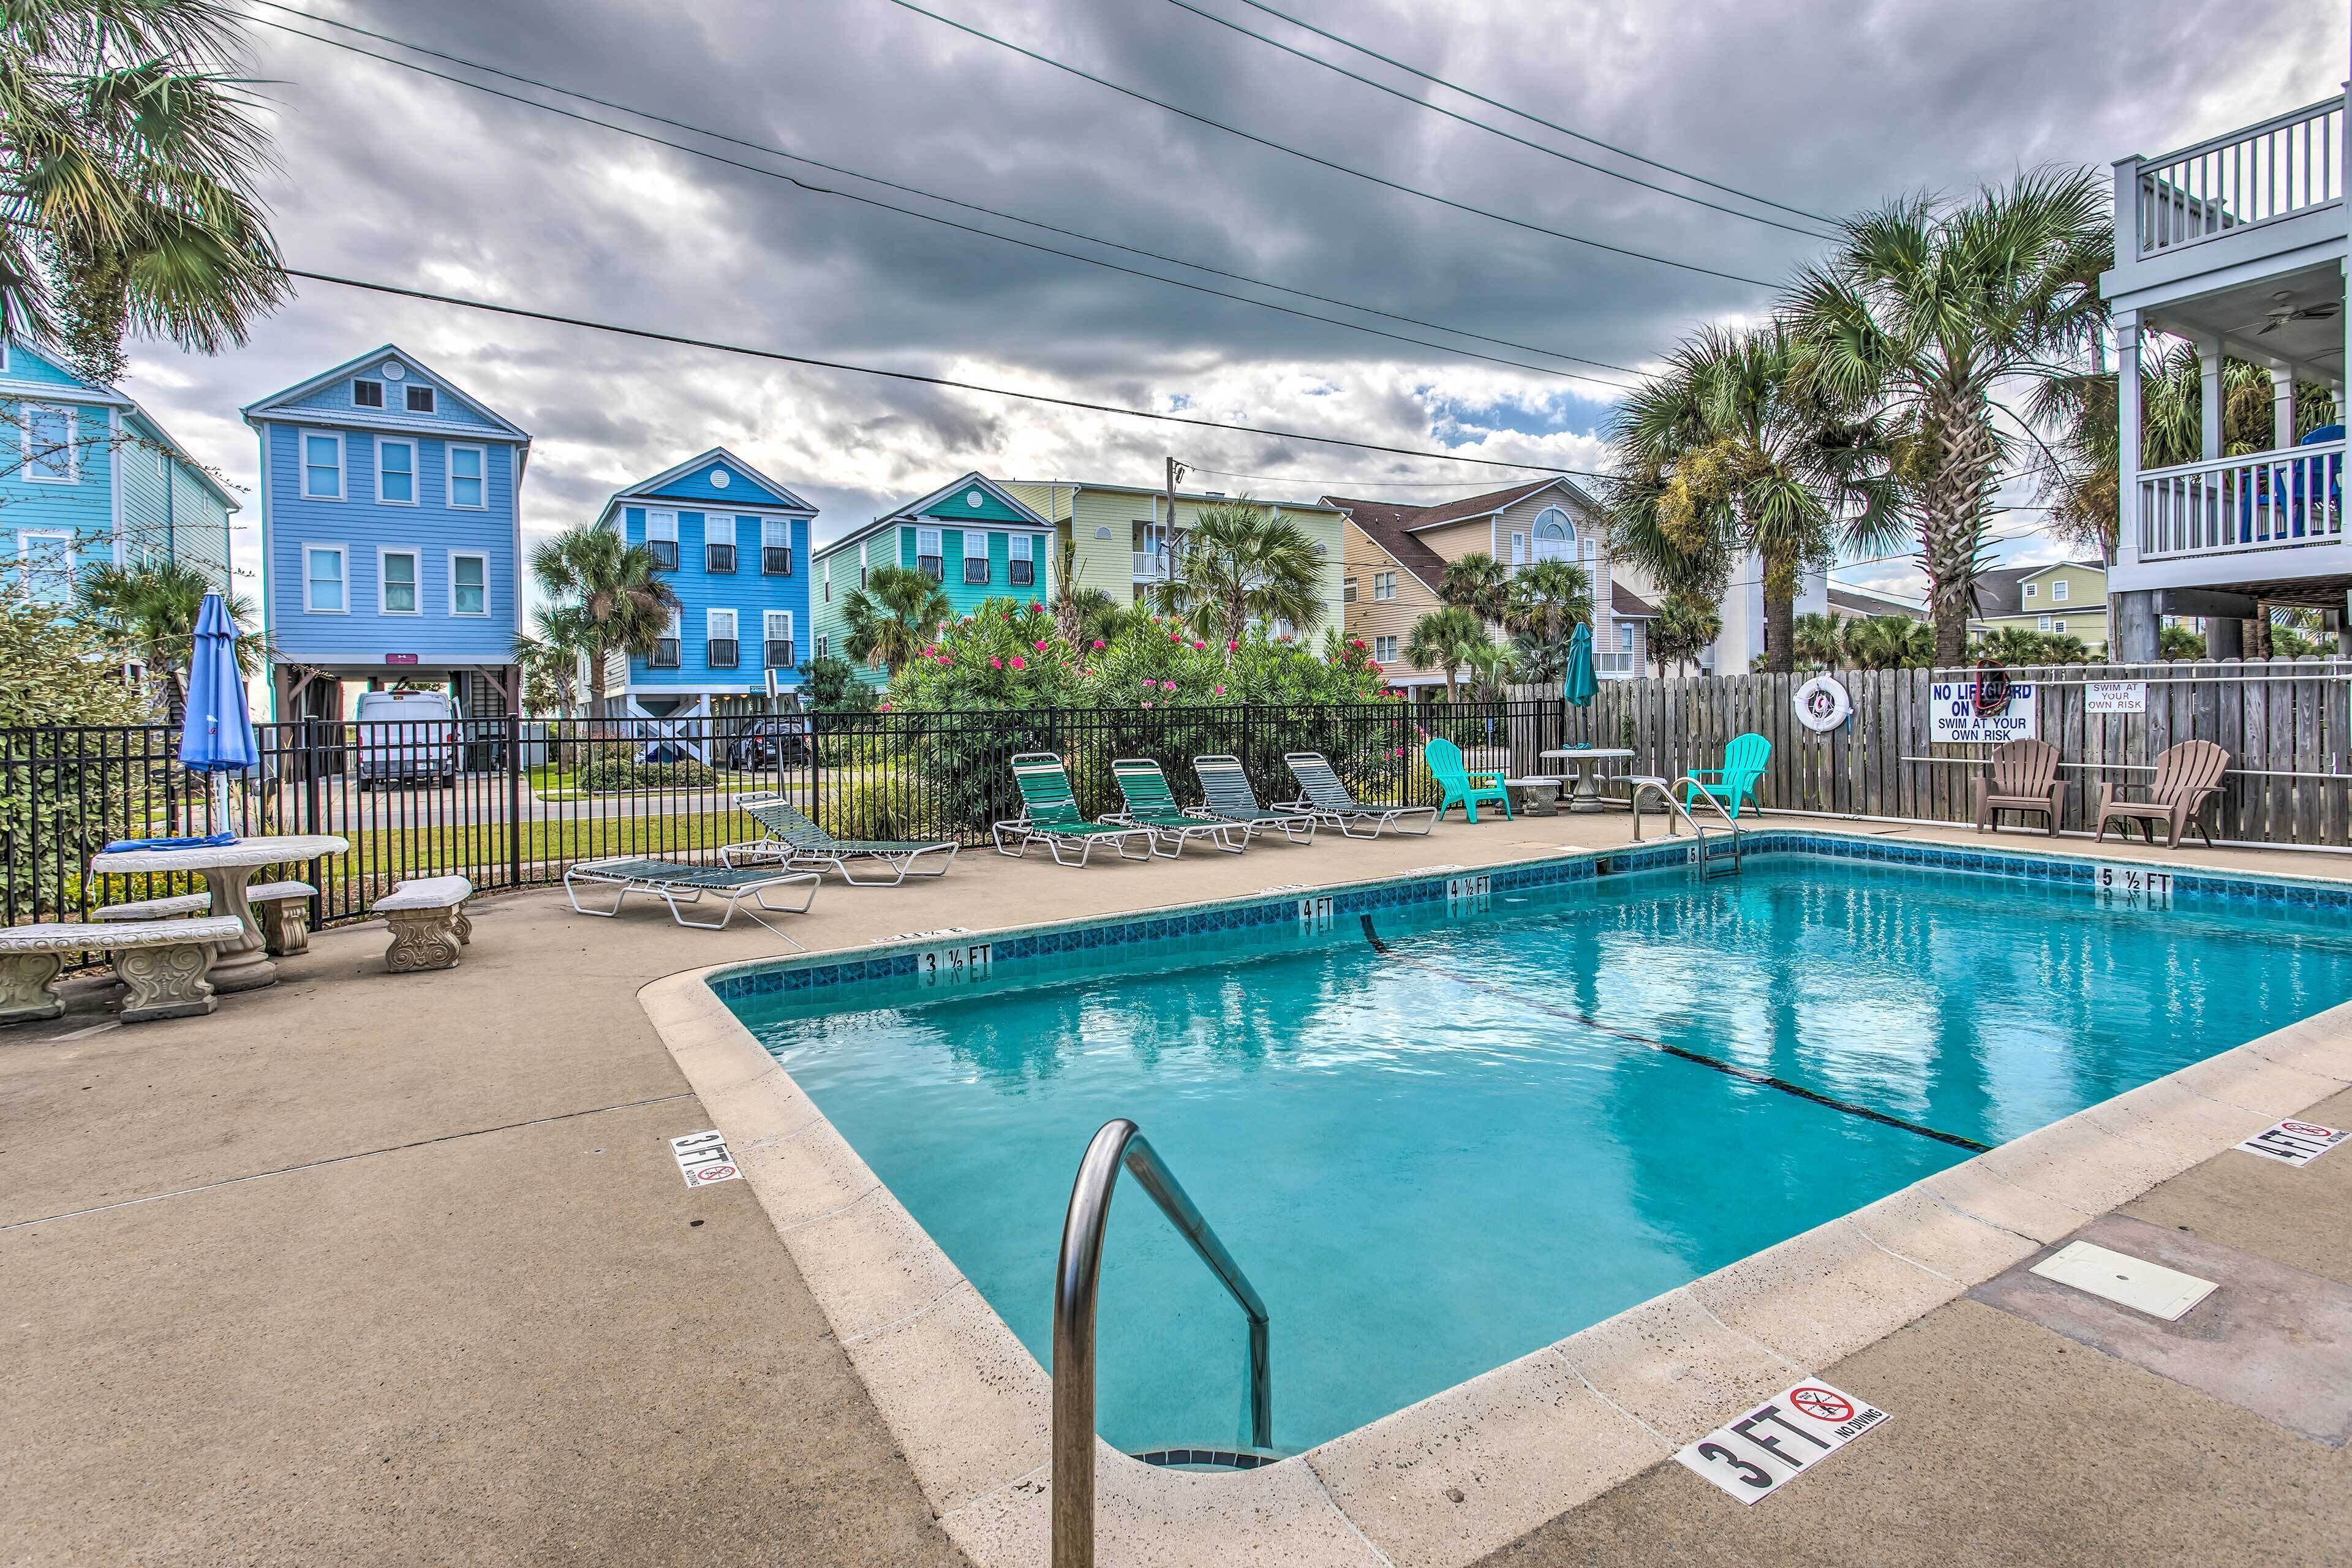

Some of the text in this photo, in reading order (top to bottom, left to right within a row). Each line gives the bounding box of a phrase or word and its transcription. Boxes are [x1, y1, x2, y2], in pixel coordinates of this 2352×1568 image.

[1934, 685, 1951, 700] NO
[1951, 701, 1969, 717] ON
[1939, 718, 2026, 729] SWIM AT YOUR
[1952, 730, 2011, 741] OWN RISK
[1691, 847, 1695, 862] 5
[1452, 880, 1458, 897] 4
[1477, 875, 1490, 894] FT
[2103, 868, 2113, 886] 5
[2147, 873, 2170, 892] FT
[1304, 897, 1332, 919] 4 FT
[926, 953, 936, 971] 3
[969, 944, 990, 965] FT
[676, 1134, 729, 1166] 3 FT
[2245, 1129, 2329, 1159] 4 FT
[1834, 1408, 1883, 1439] NO DIVING
[1697, 1404, 1831, 1488] 3 FT
